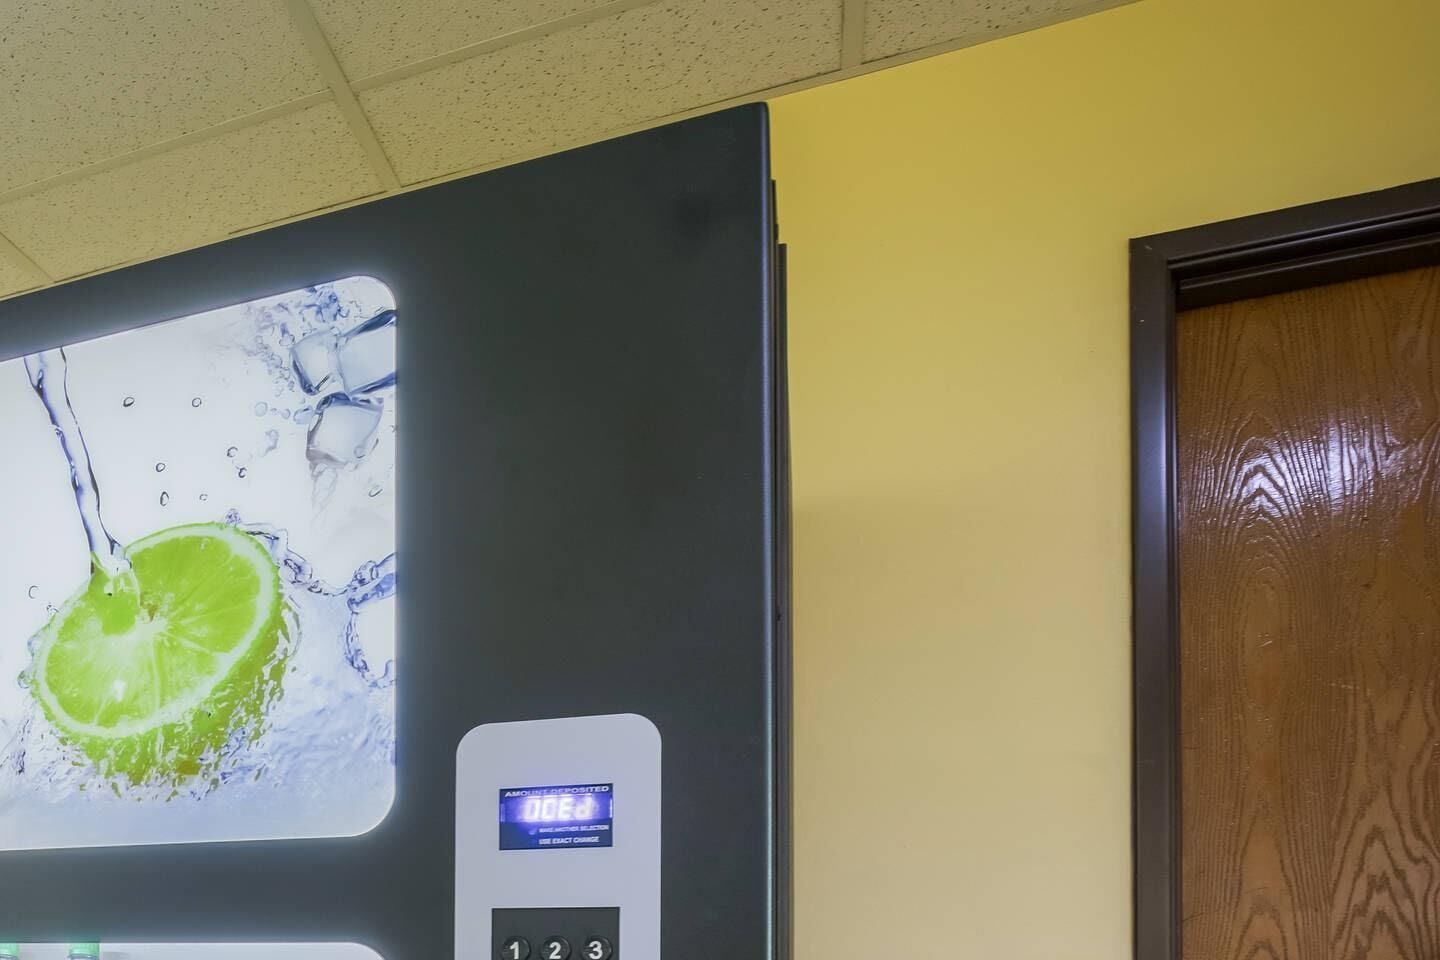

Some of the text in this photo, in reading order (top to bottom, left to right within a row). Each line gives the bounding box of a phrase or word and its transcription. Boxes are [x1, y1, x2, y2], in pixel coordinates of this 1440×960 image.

[504, 785, 609, 798] AMOUNT DEPOSITED
[509, 940, 603, 960] 1 2 3
